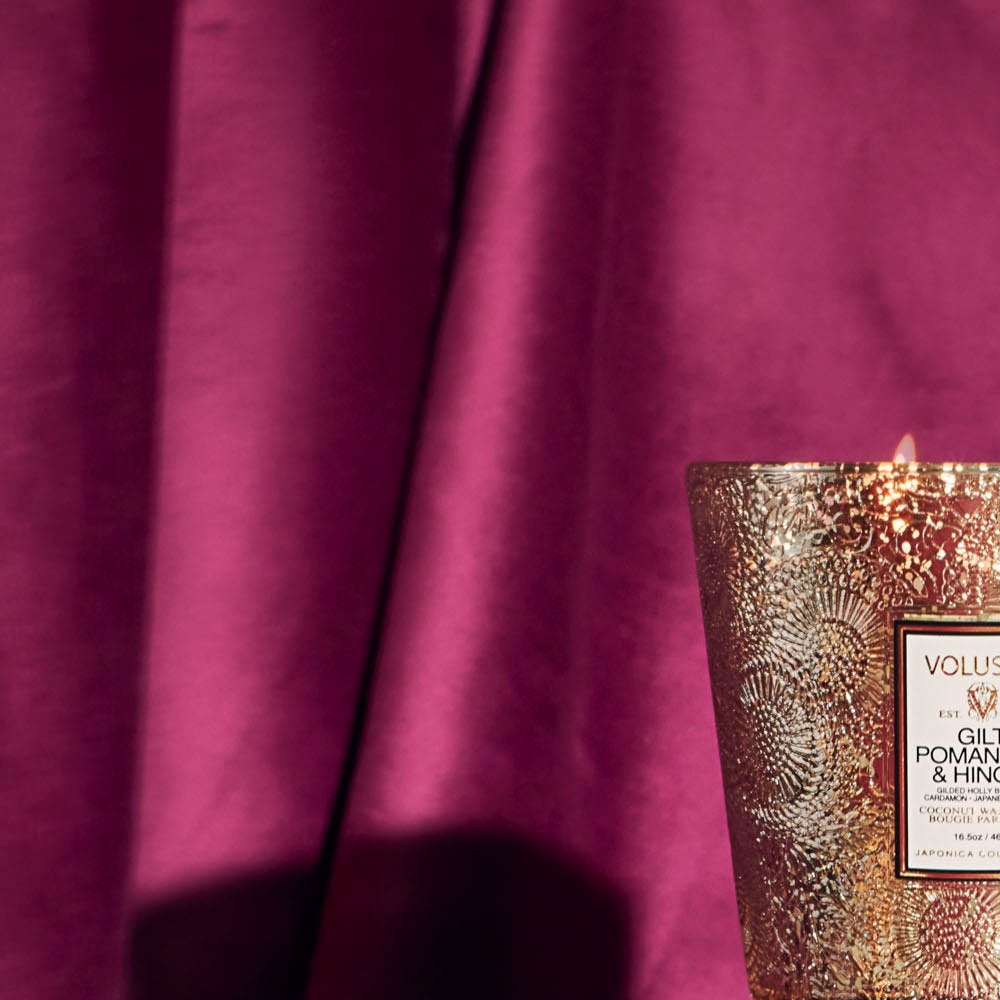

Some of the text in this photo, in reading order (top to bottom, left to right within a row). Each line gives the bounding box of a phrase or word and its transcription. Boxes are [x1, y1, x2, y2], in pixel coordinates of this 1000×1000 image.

[932, 766, 947, 783] &
[923, 794, 968, 802] CARDAMON
[919, 806, 975, 815] COCONUT
[929, 815, 974, 824] BOUGIE
[915, 850, 973, 858] JAPONICA
